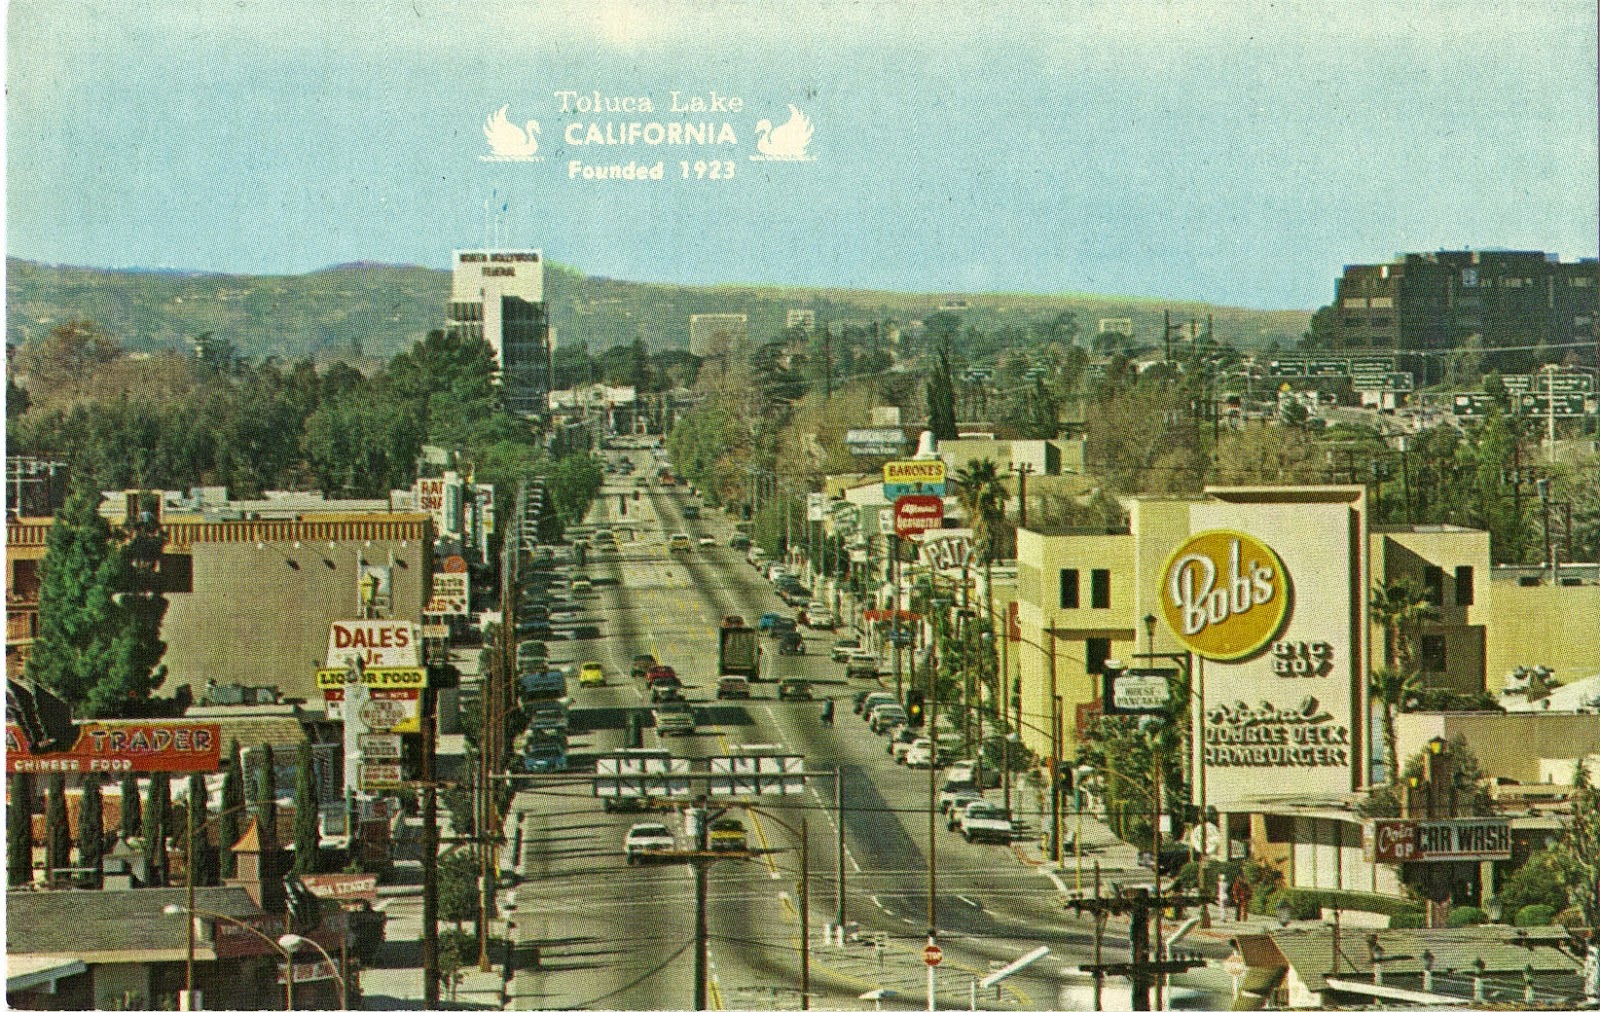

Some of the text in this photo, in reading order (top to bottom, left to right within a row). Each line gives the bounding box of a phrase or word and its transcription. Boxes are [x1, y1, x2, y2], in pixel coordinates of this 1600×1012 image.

[1170, 538, 1275, 636] Bob's
[333, 624, 410, 649] DALE'S
[1272, 640, 1333, 660] BIG
[381, 672, 423, 684] FOOD
[1272, 658, 1334, 678] BOY
[89, 729, 213, 752] TRADER
[1204, 726, 1349, 746] DOUBLE DECK
[15, 759, 132, 771] CHINESE FOOD
[1204, 747, 1349, 767] HAMBURGER
[1418, 826, 1453, 852] CAR
[1457, 825, 1510, 851] WASH
